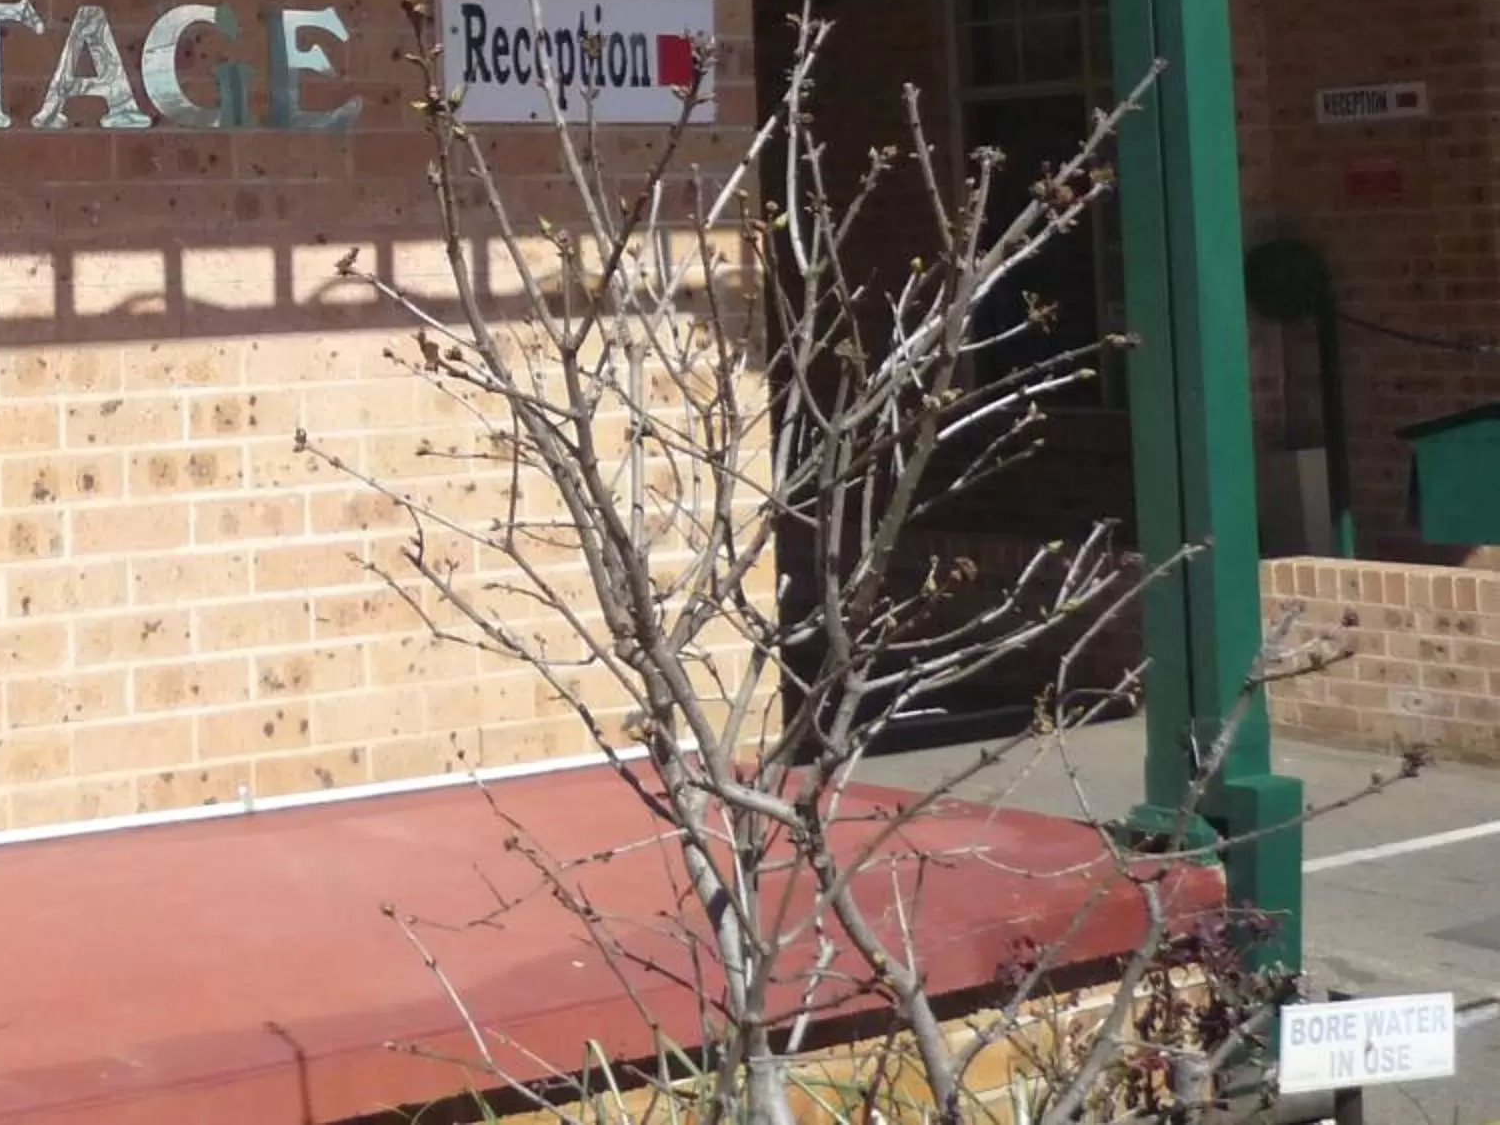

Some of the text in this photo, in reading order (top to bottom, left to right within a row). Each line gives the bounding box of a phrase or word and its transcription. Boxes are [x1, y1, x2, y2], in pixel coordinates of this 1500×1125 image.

[1290, 1005, 1449, 1046] BORE WATER
[1330, 1044, 1413, 1081] IN USE
